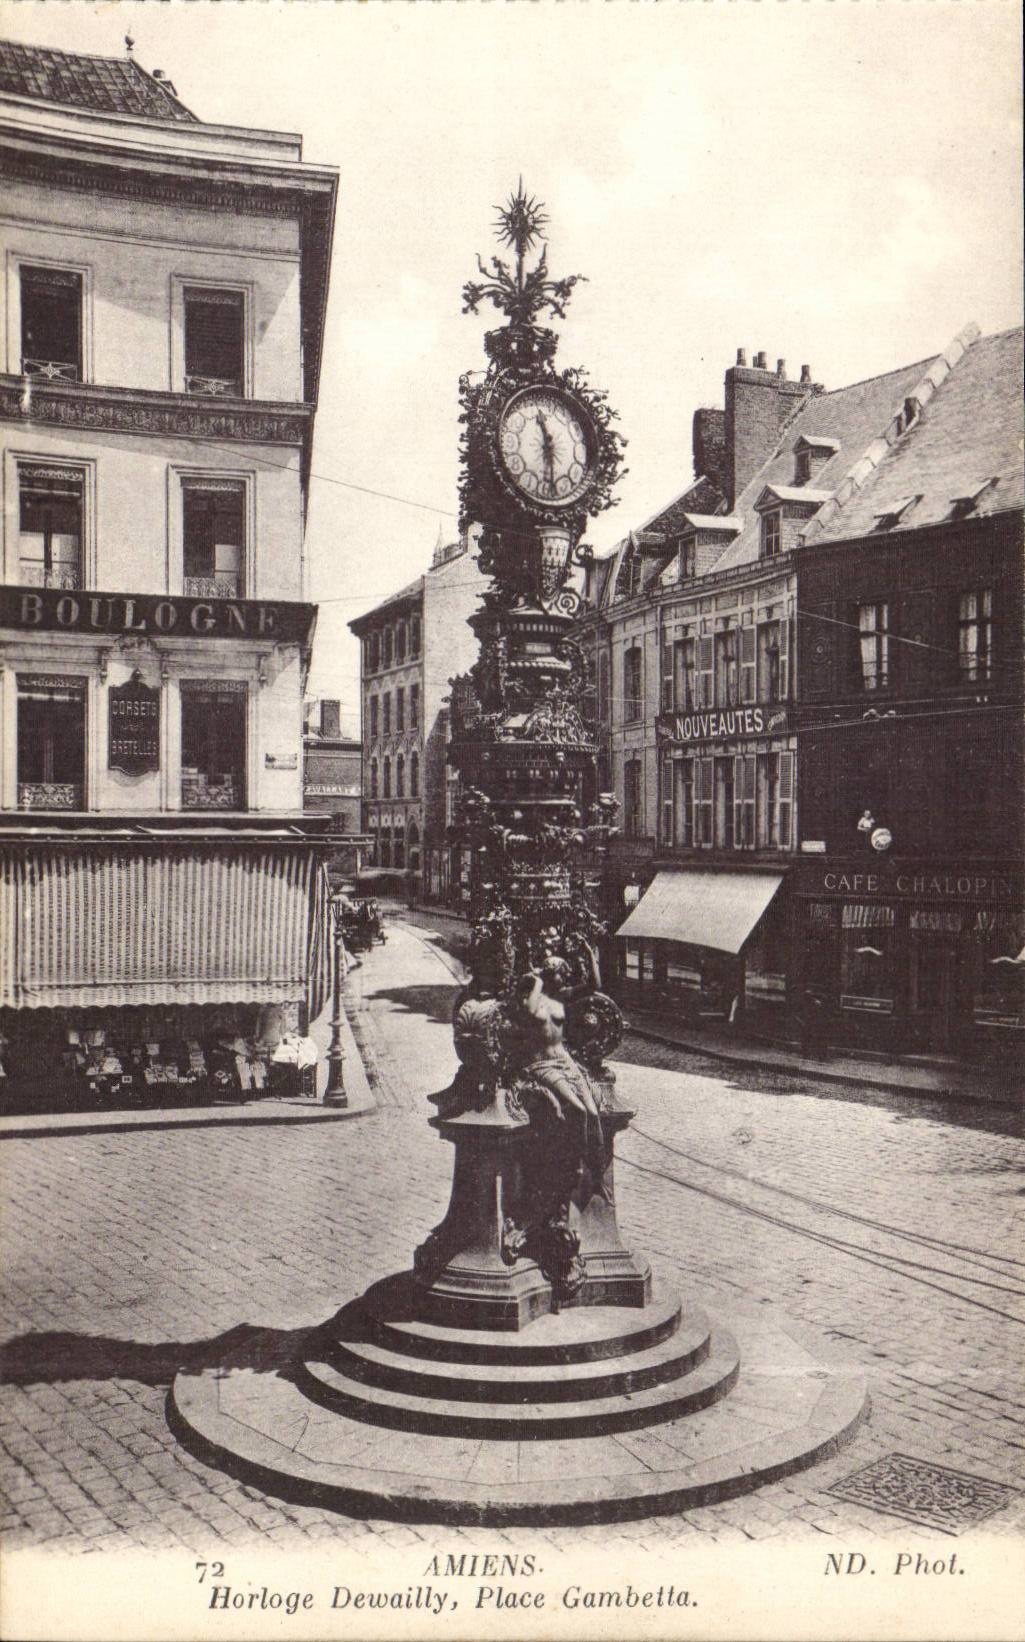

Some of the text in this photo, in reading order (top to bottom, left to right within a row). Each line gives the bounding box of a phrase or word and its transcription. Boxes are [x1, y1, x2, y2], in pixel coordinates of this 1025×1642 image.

[19, 593, 282, 635] BOULOGNE
[112, 700, 157, 716] CORSETS
[676, 707, 764, 741] NOUVEAUTES
[823, 873, 880, 892] CAFE
